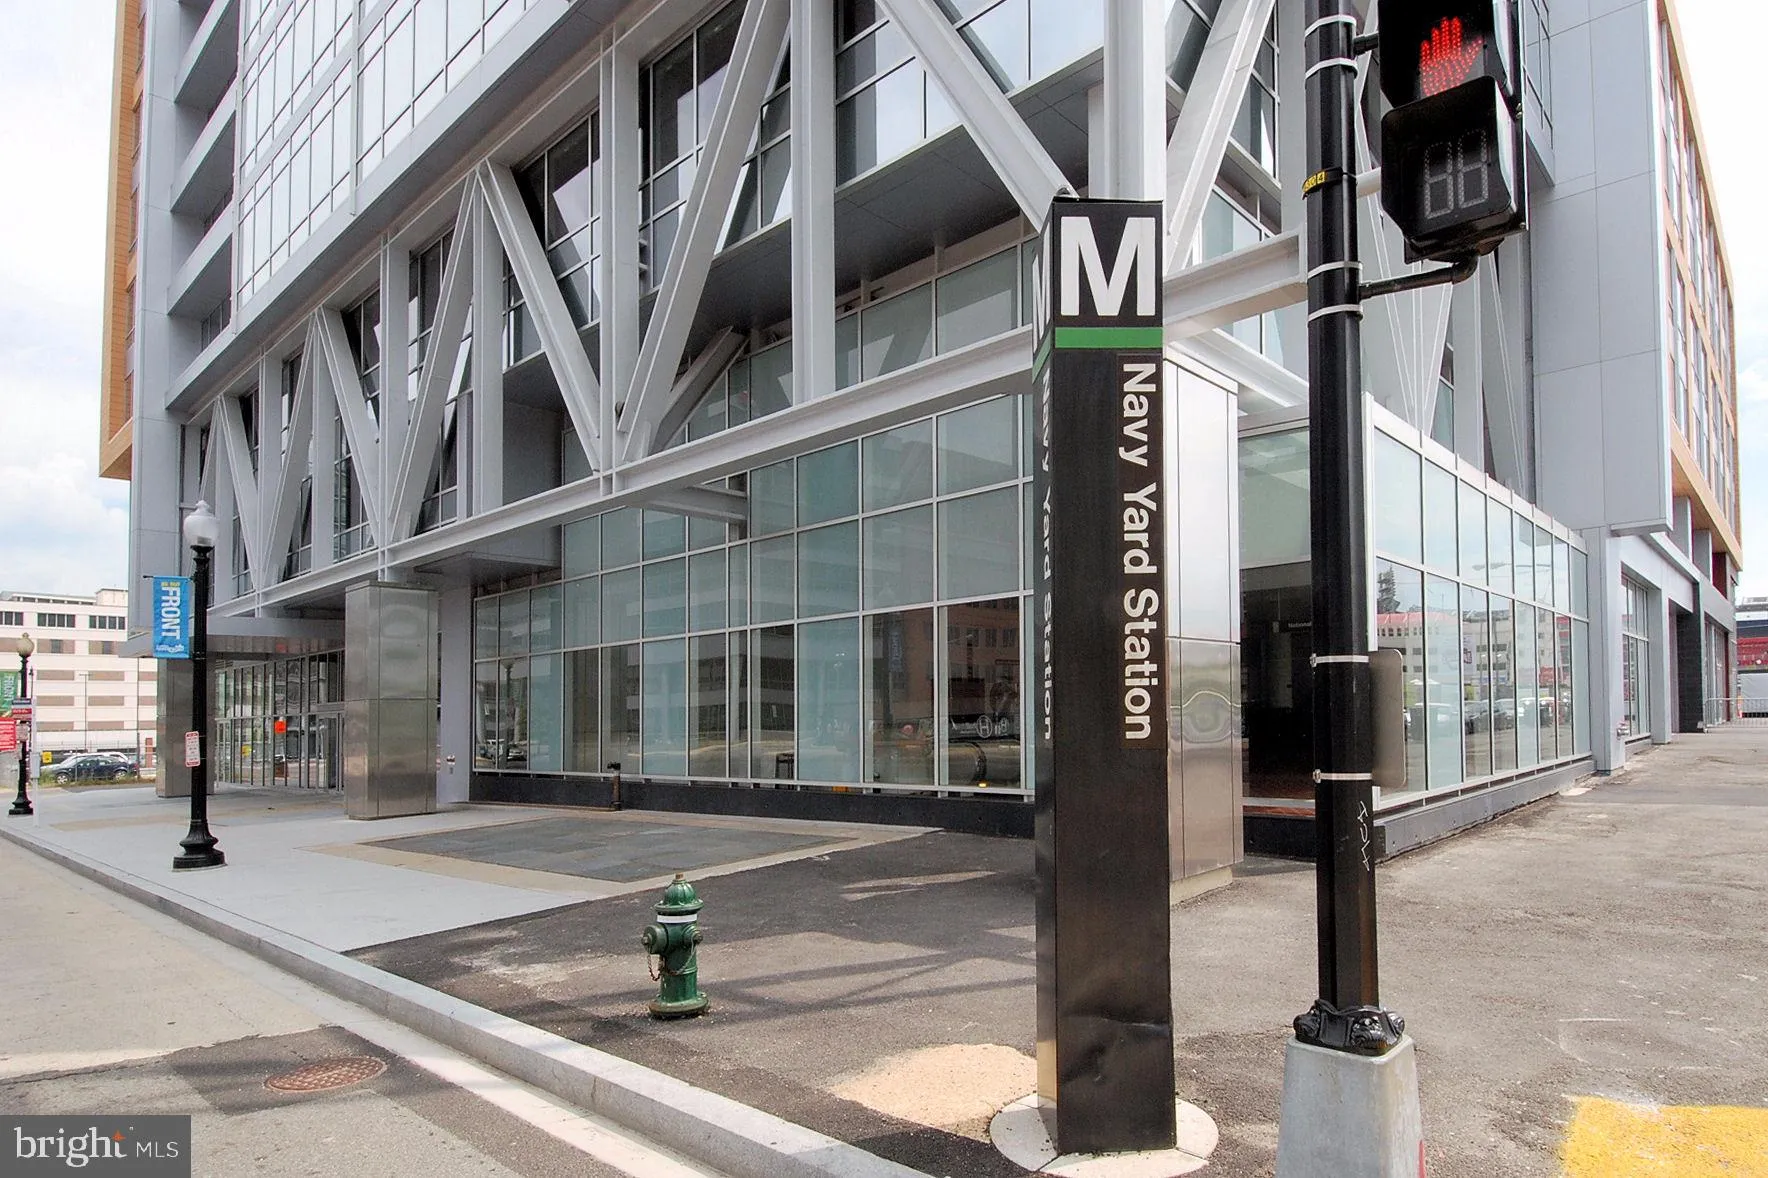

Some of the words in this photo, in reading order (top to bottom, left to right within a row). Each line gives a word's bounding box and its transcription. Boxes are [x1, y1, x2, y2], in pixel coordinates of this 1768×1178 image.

[1060, 216, 1156, 316] M
[1119, 363, 1157, 467] Navy
[1123, 482, 1158, 574] Yard
[161, 586, 181, 640] FRONT
[1123, 588, 1159, 740] Station
[1043, 591, 1053, 740] Station
